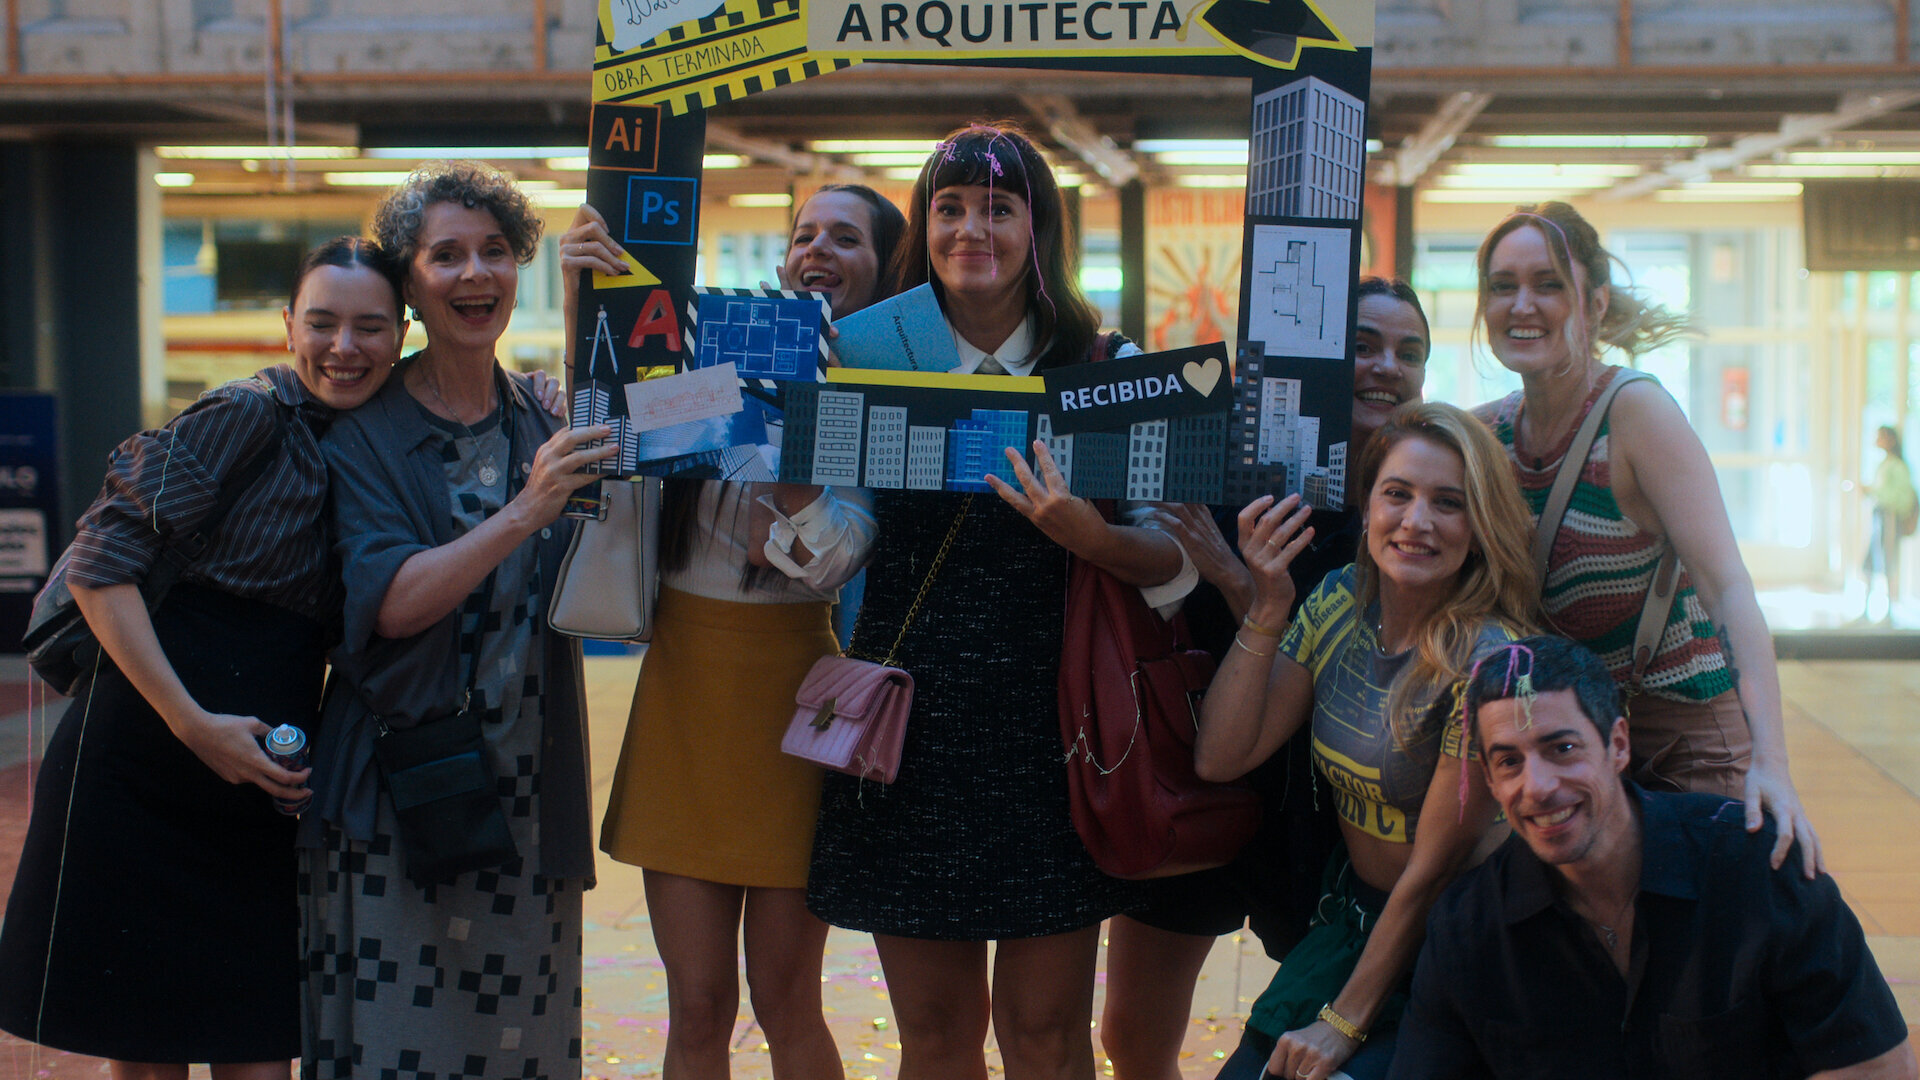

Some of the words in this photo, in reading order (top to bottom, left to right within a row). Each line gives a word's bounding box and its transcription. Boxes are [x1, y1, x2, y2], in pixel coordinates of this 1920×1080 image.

[836, 0, 1183, 47] ARQUITECTA
[604, 64, 654, 93] OBRA
[657, 35, 765, 78] TERMINADA
[605, 117, 643, 152] Ai
[641, 190, 680, 226] Ps
[893, 315, 919, 371] Arquitectura
[1060, 373, 1184, 412] RECIBIDA
[1312, 593, 1349, 632] Disease
